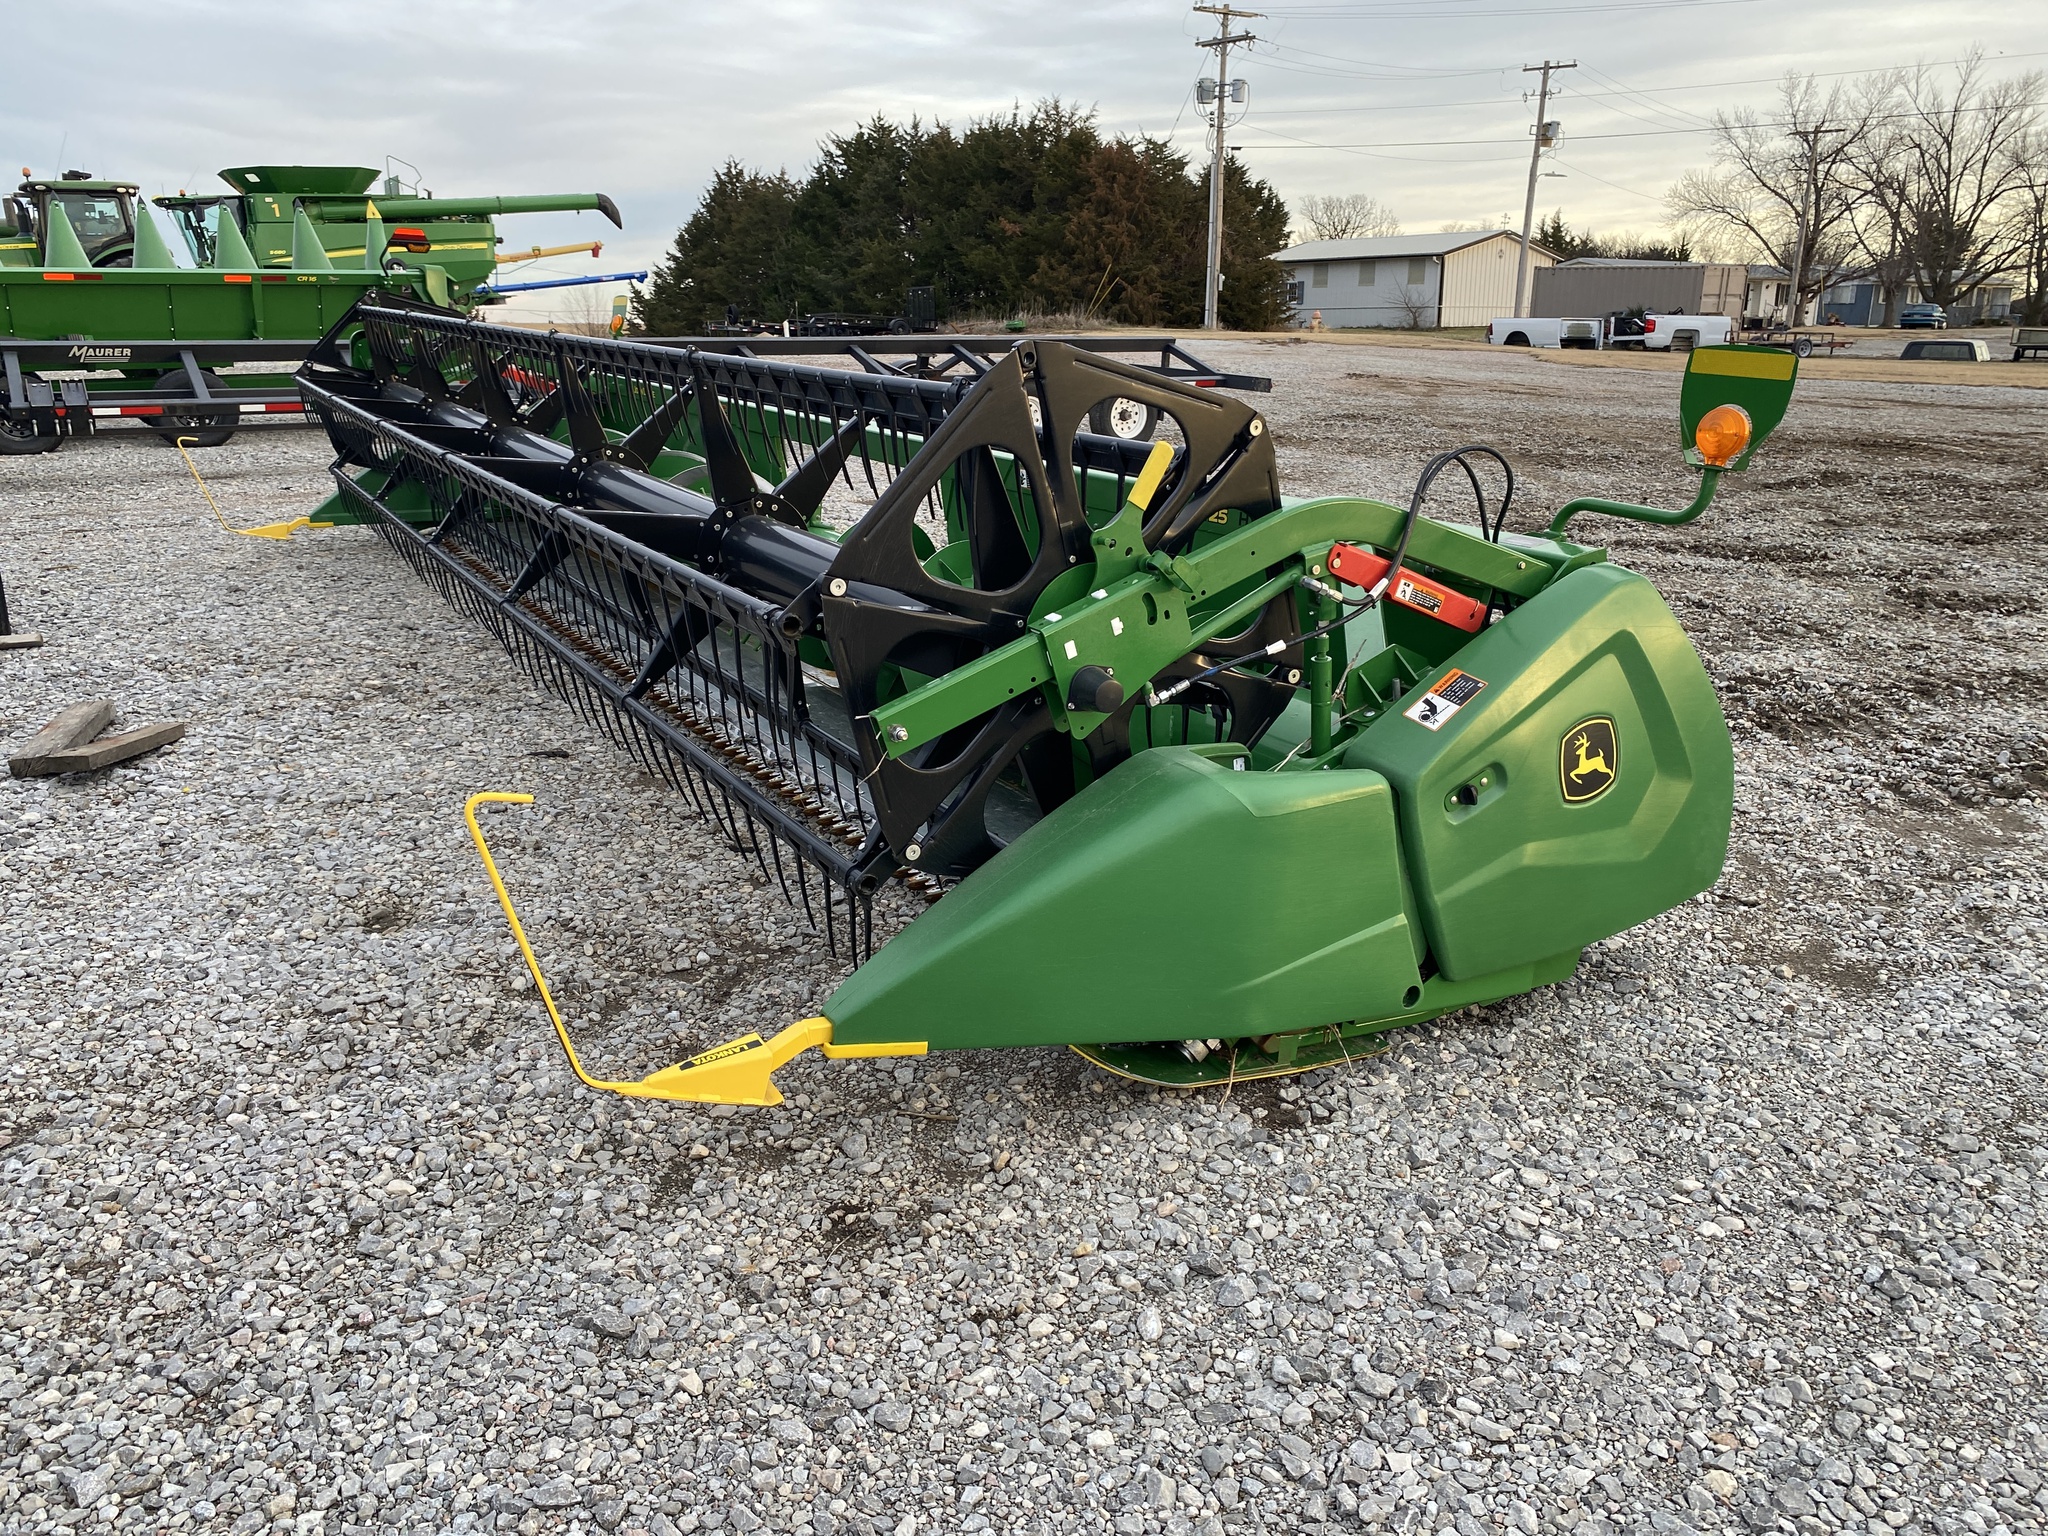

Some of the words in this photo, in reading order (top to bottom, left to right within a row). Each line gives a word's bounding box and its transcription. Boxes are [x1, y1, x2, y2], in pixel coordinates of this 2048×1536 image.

[271, 204, 280, 217] 1
[68, 345, 132, 363] MAURER
[691, 1044, 749, 1065] LANKOTA
